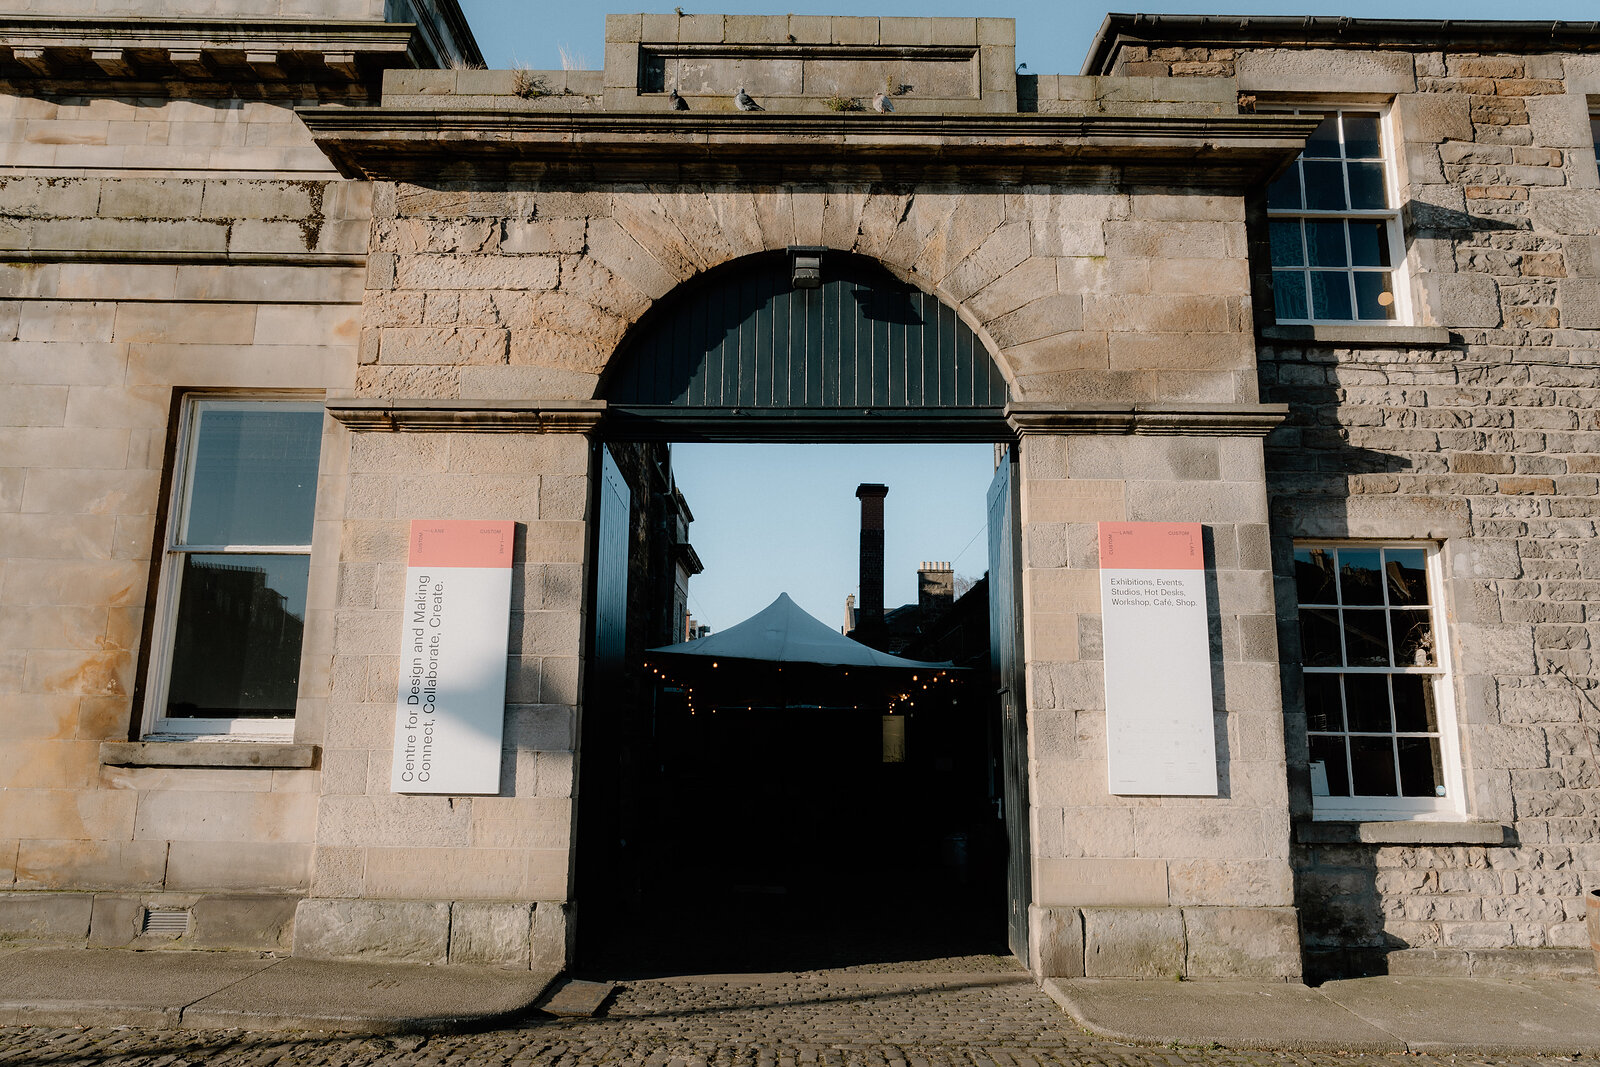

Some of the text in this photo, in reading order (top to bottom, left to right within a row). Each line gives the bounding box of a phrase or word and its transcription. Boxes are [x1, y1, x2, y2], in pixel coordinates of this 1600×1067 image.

[1110, 578, 1185, 587] Exhibitions, Events,
[1111, 588, 1187, 598] Studios, Hot Desks,
[1111, 598, 1198, 608] Workshop, Café, Shop.
[401, 575, 431, 782] Centre for Design and Making
[418, 581, 444, 782] Connect, Collaborate, Create.
